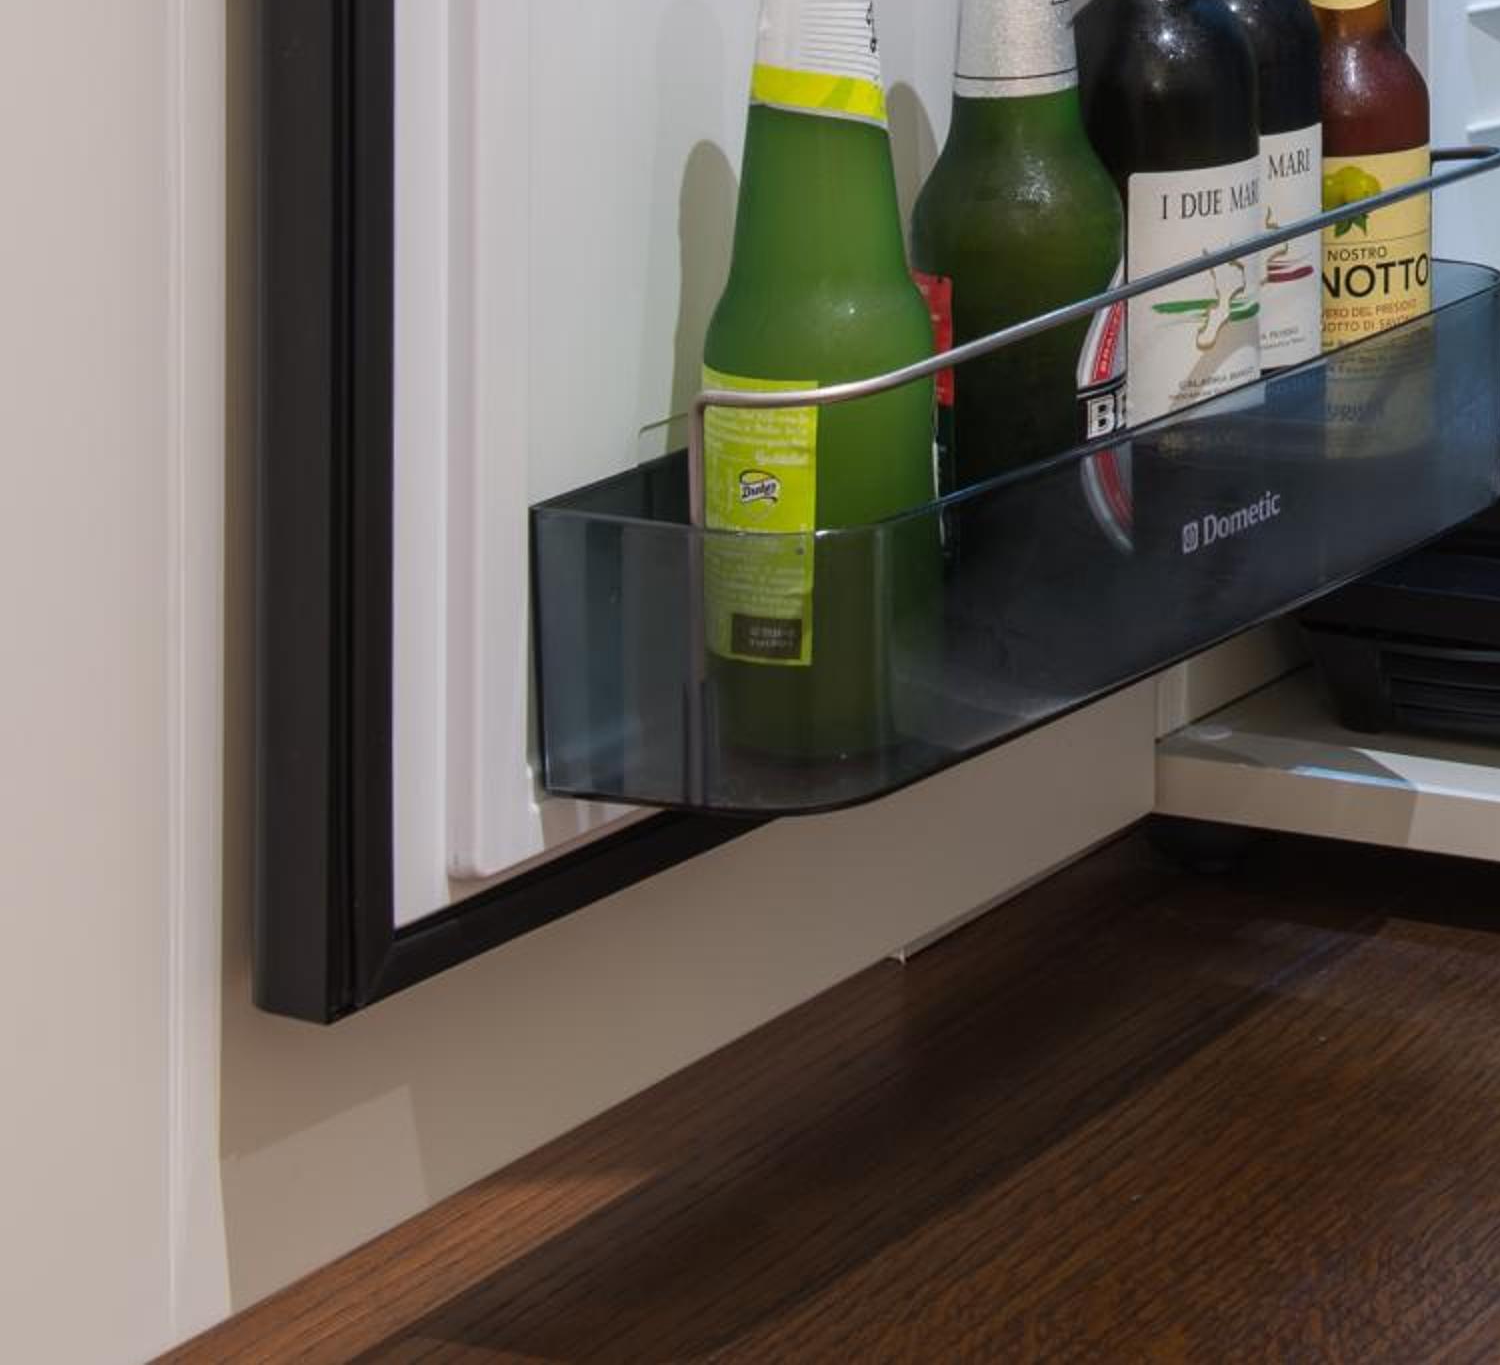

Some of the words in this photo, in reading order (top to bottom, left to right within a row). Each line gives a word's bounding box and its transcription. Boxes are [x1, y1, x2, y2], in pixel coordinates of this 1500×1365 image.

[1267, 148, 1311, 180] MARI
[1162, 195, 1169, 220] I
[1180, 189, 1224, 220] DUE
[1327, 245, 1388, 263] NOSTRO
[1321, 252, 1430, 299] NOTTO
[1203, 490, 1281, 546] Dometic
